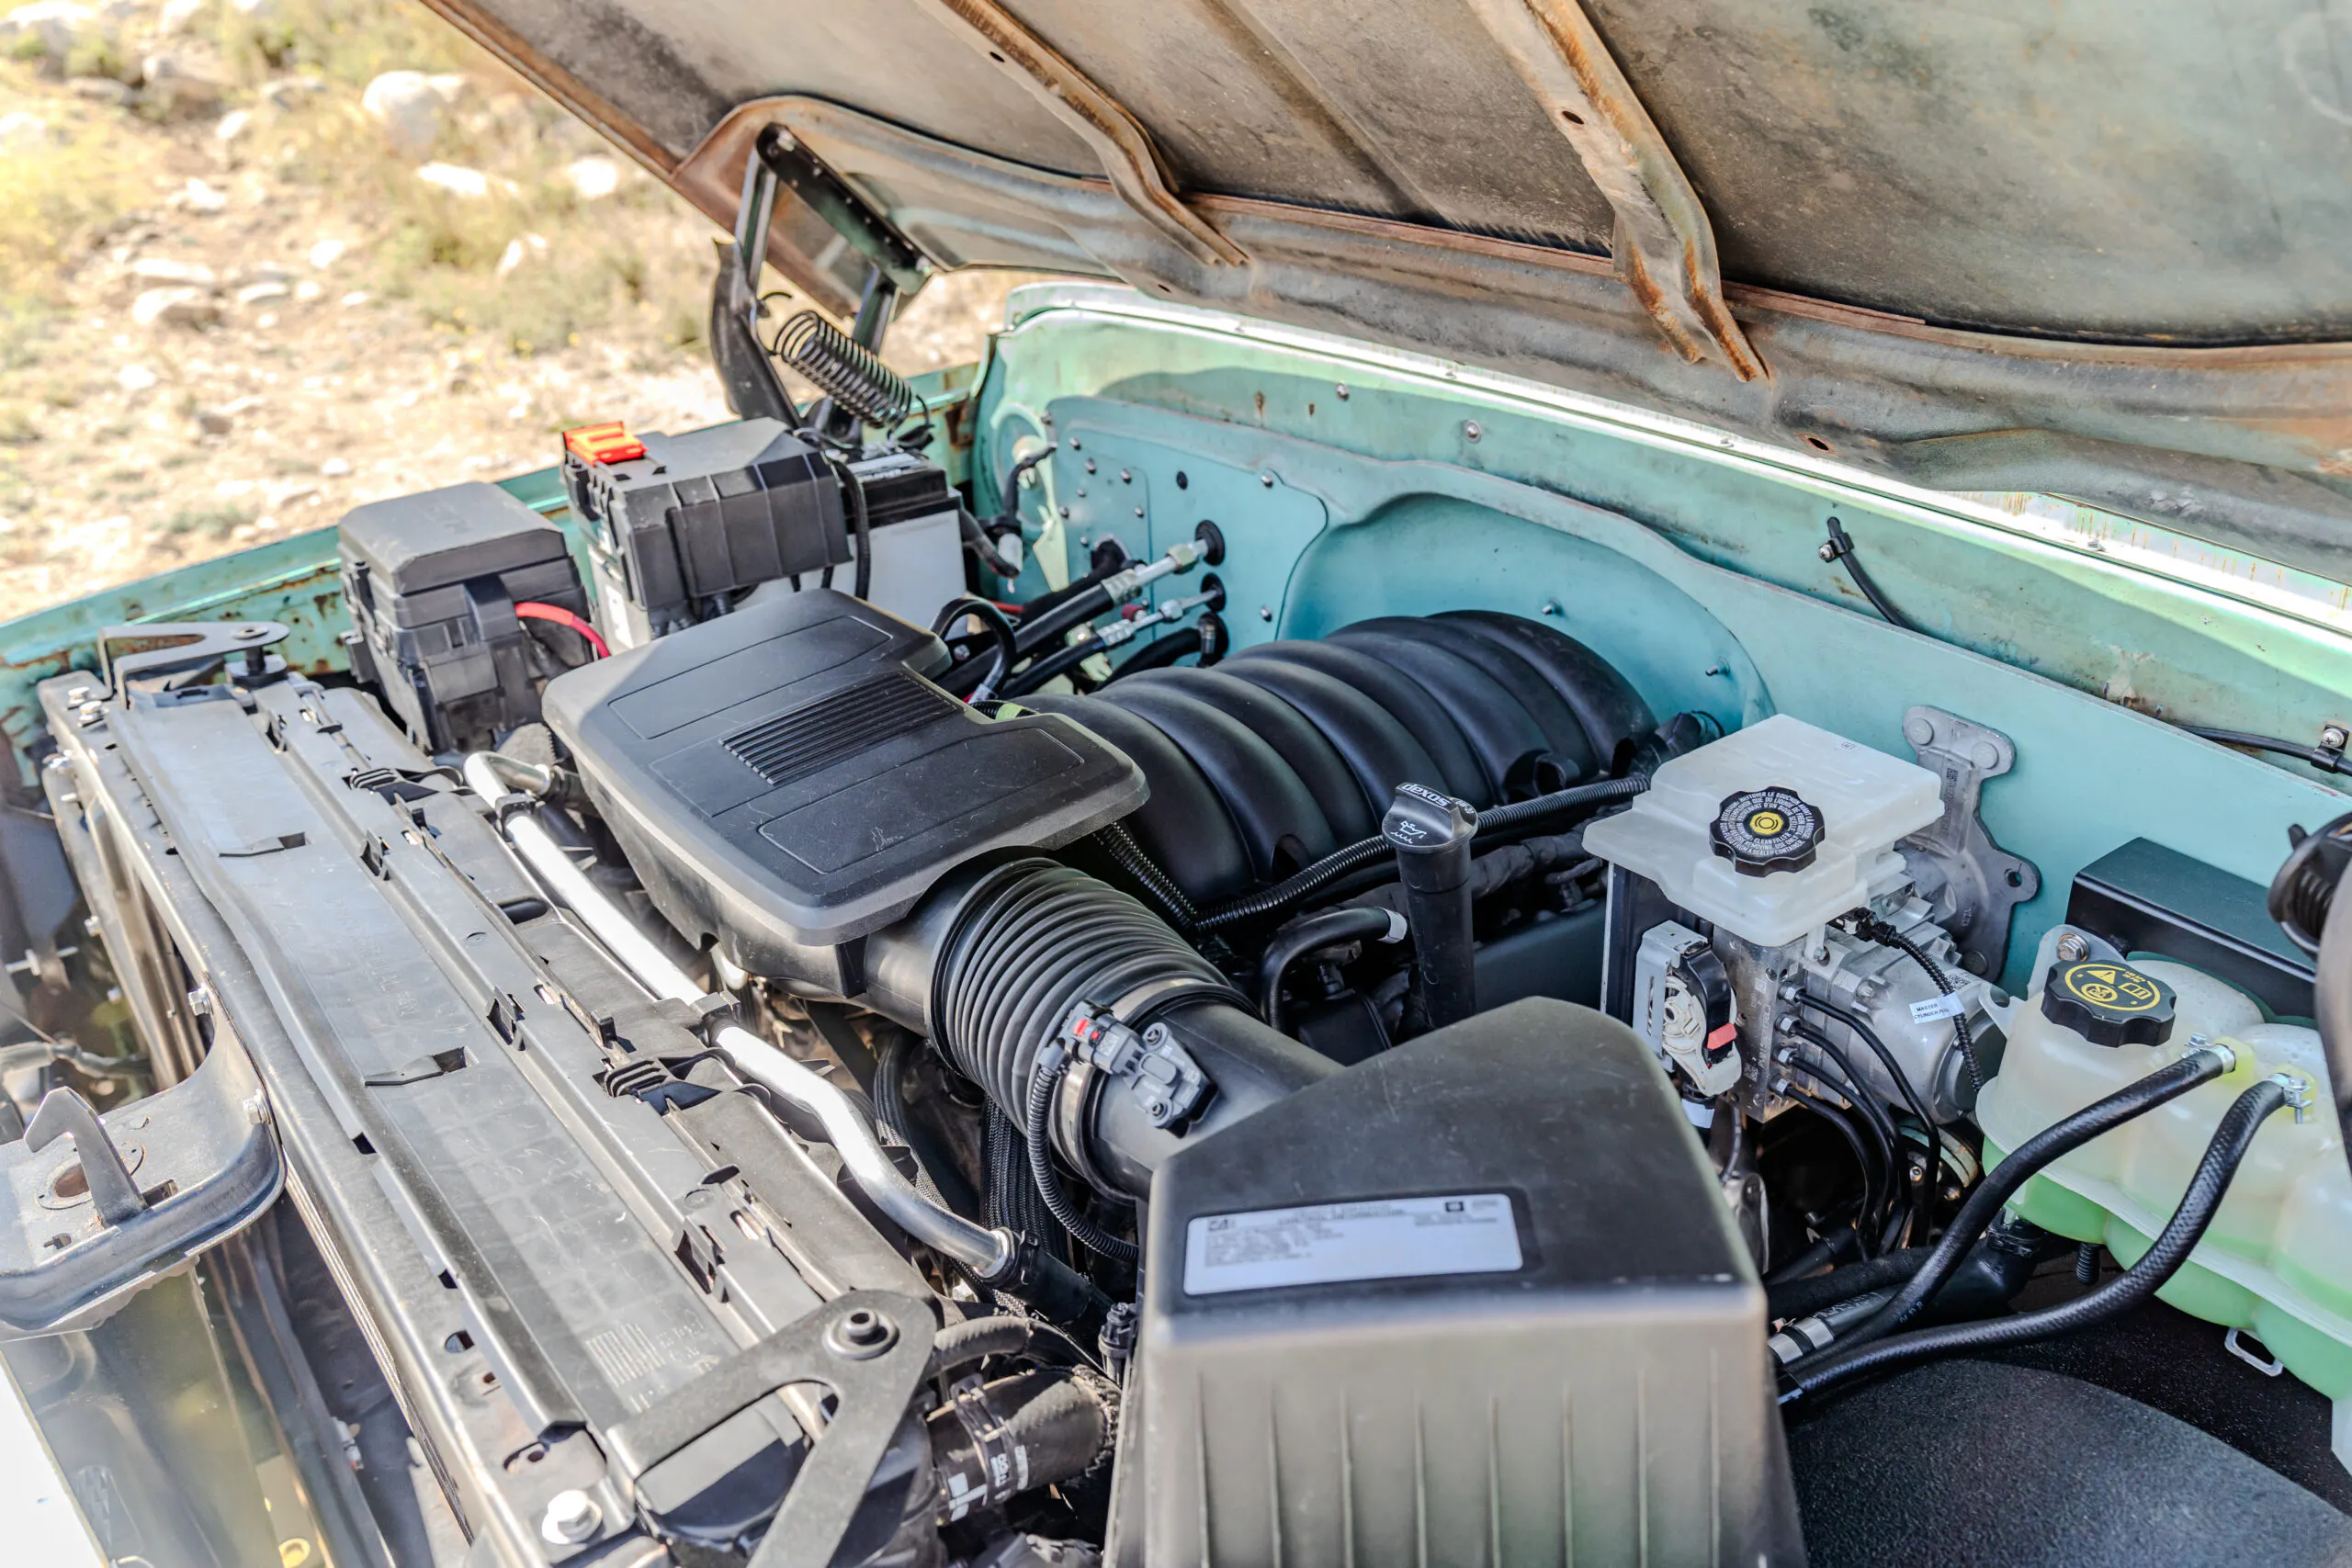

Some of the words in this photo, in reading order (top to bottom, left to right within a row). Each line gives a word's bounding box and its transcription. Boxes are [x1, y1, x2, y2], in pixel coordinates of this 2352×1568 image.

[1401, 784, 1452, 807] dexos
[1775, 793, 1801, 805] BOUCHON
[1773, 797, 1794, 807] LIQUIDE
[1772, 832, 1793, 844] FILLER
[1785, 836, 1800, 846] ONLY
[1916, 1003, 1939, 1011] MASTER
